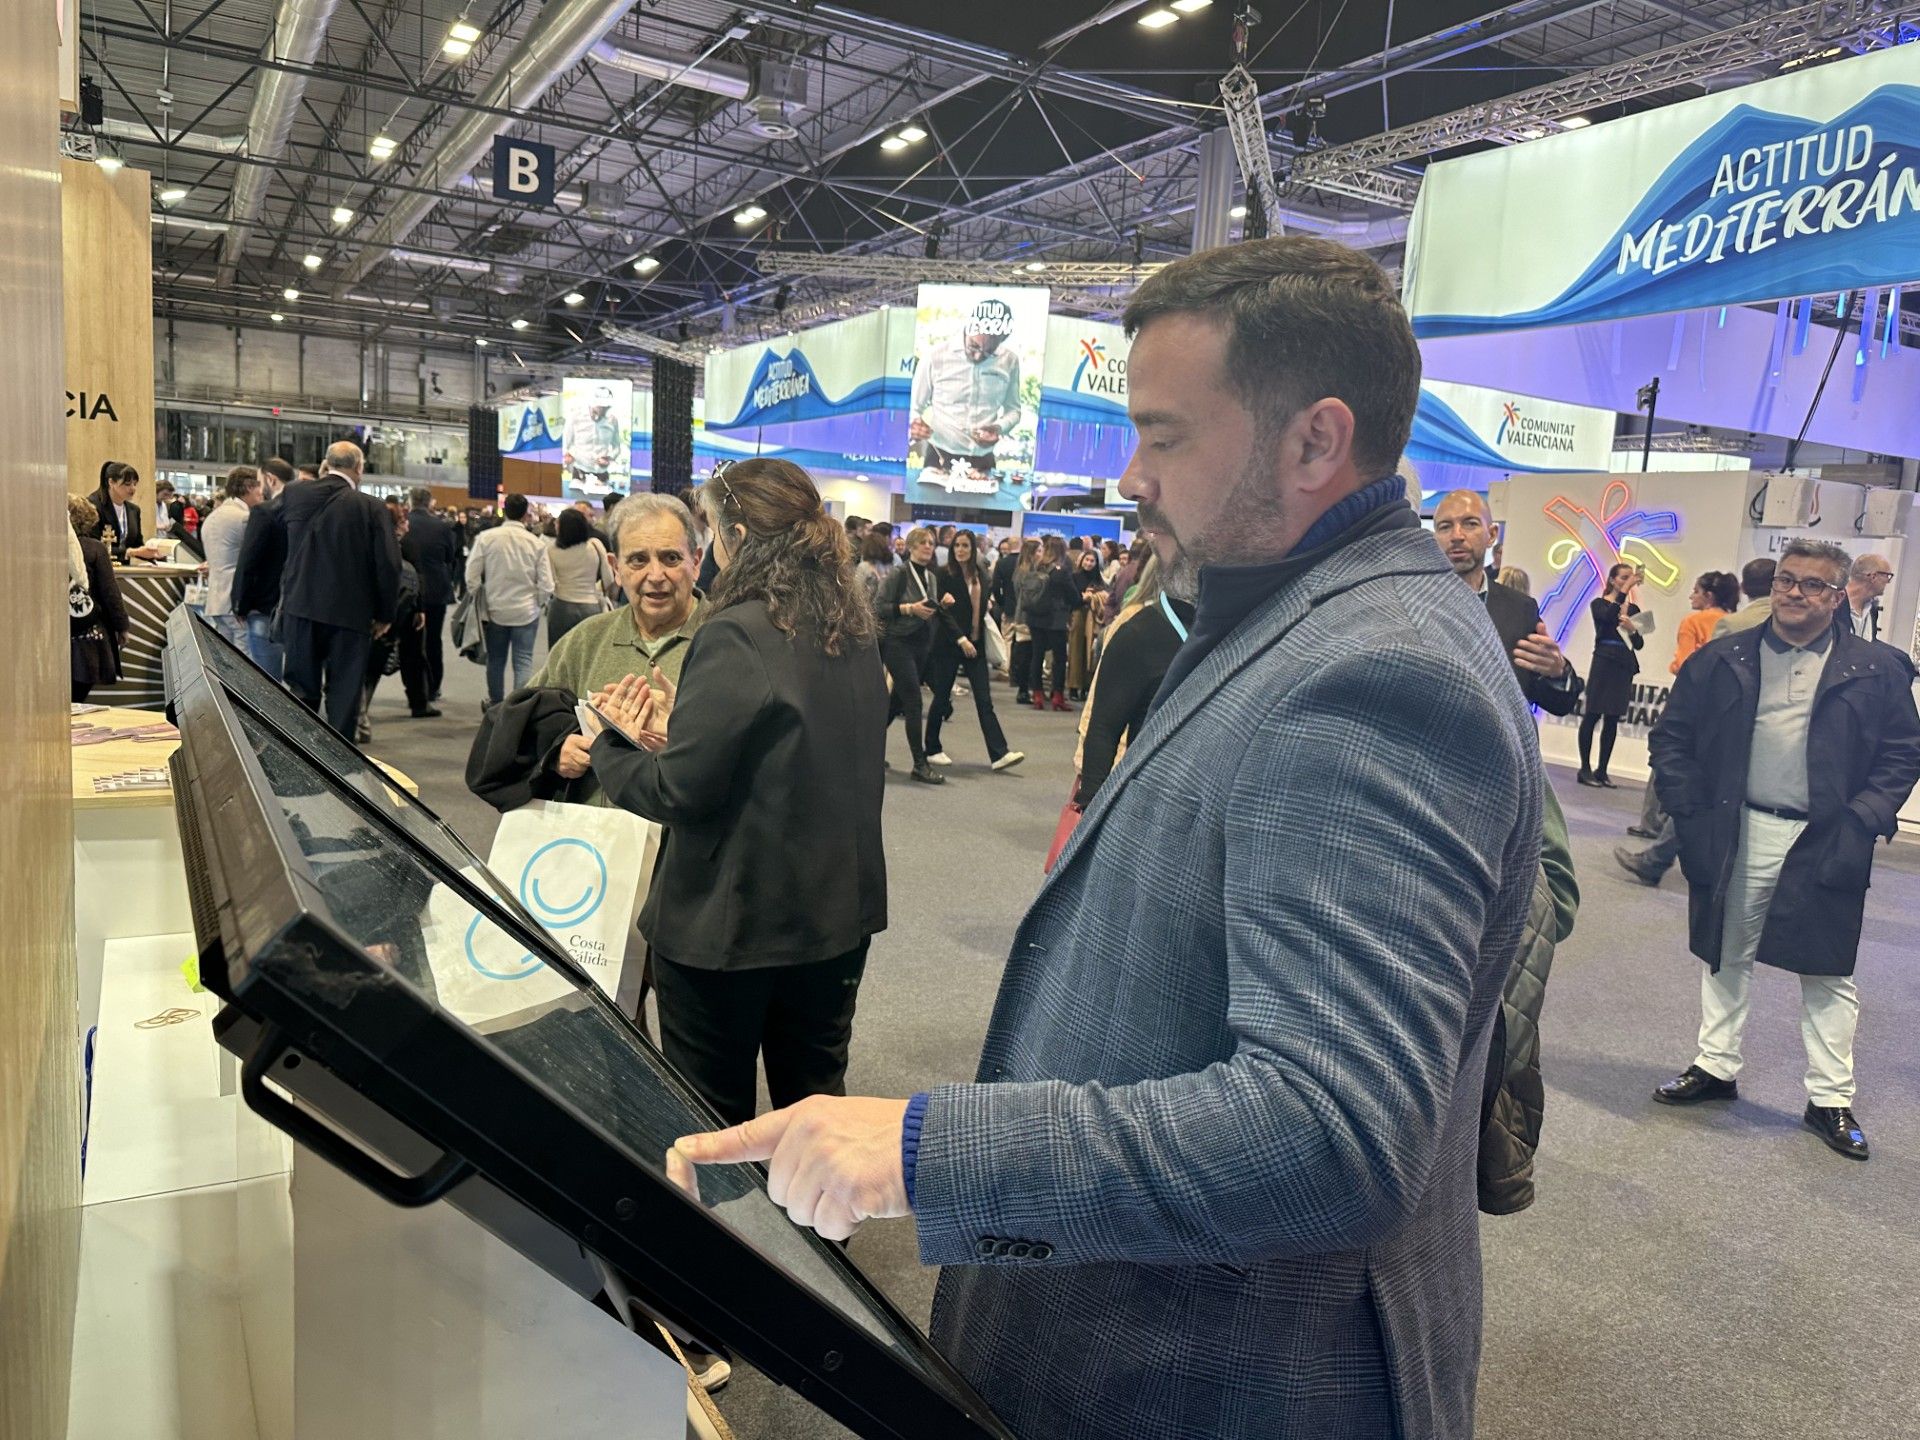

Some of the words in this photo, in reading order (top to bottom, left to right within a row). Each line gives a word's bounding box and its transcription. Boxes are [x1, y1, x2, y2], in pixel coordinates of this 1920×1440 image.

[508, 147, 539, 194] B
[1710, 124, 1873, 198] ACTITUD
[1087, 373, 1128, 395] VALE
[1521, 416, 1576, 437] COMUNITAT
[1506, 429, 1575, 453] VALENCIANA
[569, 934, 606, 951] Costa
